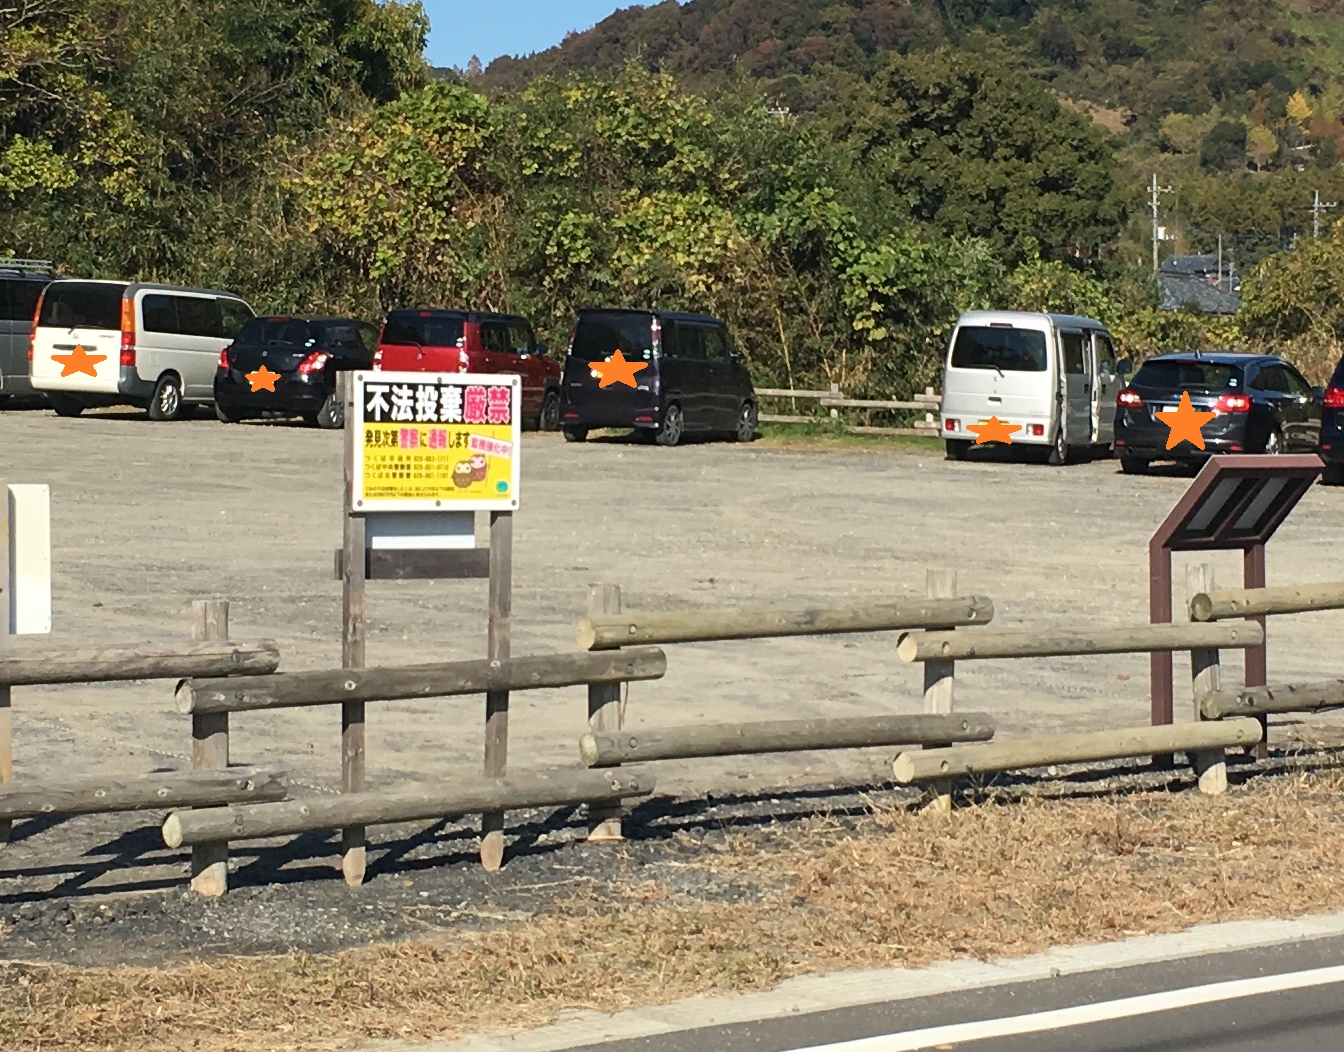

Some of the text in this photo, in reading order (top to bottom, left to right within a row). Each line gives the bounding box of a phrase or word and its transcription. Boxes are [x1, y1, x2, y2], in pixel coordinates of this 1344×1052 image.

[366, 384, 511, 424] 不法投棄厳禁
